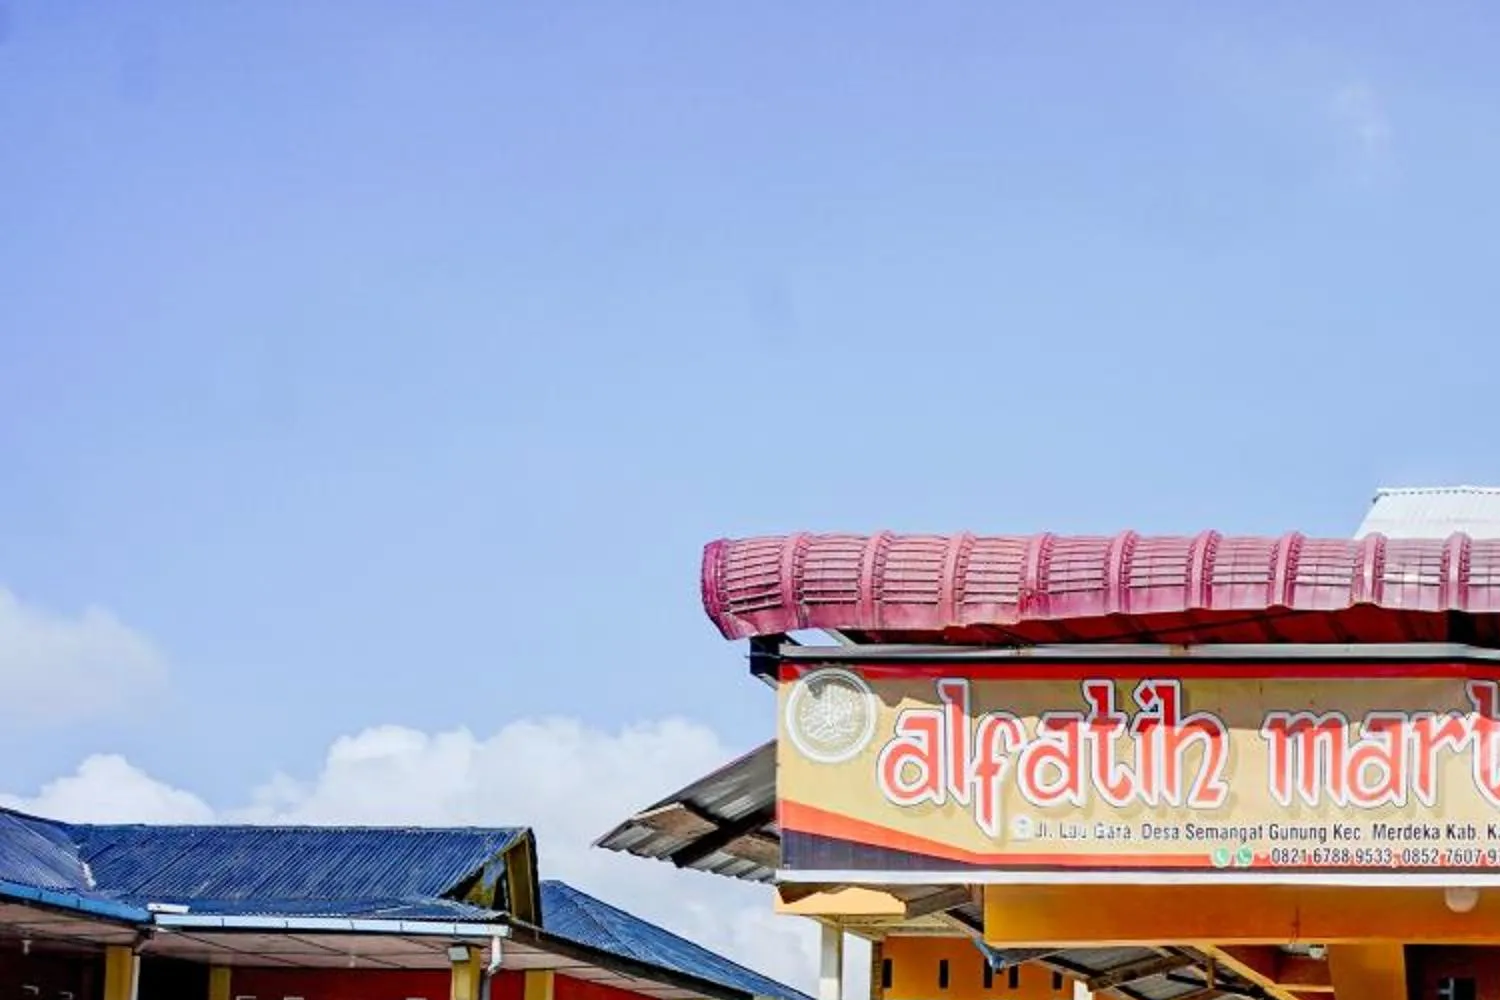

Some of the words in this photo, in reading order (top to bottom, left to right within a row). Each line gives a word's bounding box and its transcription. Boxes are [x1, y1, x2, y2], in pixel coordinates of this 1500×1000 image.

[878, 678, 1229, 839] alfatih
[1142, 823, 1179, 839] Desa
[1186, 823, 1262, 843] Semangat
[1269, 823, 1326, 843] Gunung
[1373, 823, 1440, 840] Merdeka
[1272, 848, 1306, 864] 0821
[1313, 848, 1349, 864] 6788
[1402, 848, 1439, 864] 0852
[1445, 848, 1481, 864] 7607
